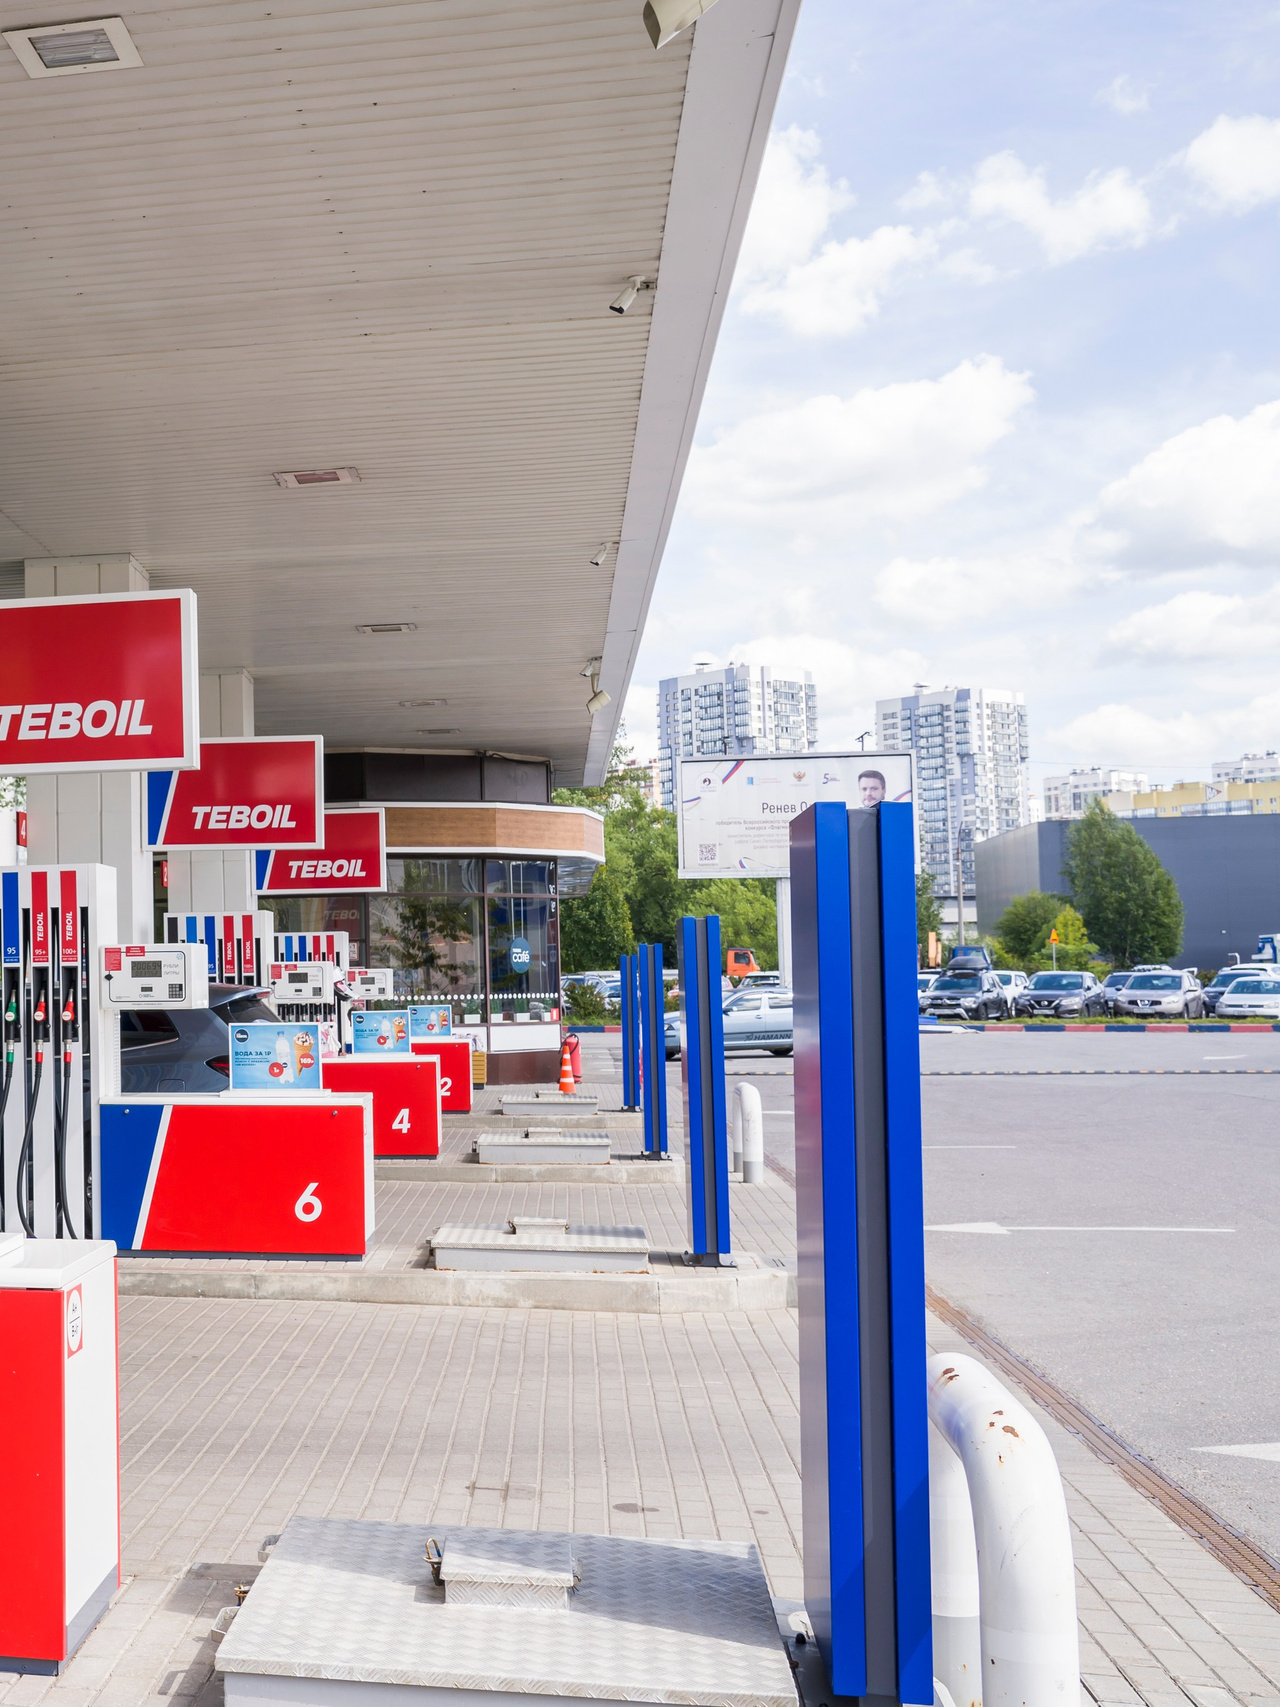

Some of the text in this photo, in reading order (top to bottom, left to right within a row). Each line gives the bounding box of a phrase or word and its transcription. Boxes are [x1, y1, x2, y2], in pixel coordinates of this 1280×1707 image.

[191, 804, 296, 830] TEBOIL
[762, 802, 796, 814] Ренев
[21, 819, 26, 839] 4
[287, 858, 366, 879] TEBOIL
[7, 947, 16, 955] 95
[512, 950, 530, 963] café
[754, 1033, 792, 1041] HAMANN
[440, 1077, 452, 1096] 2
[391, 1108, 411, 1134] 4
[294, 1182, 323, 1222] 6
